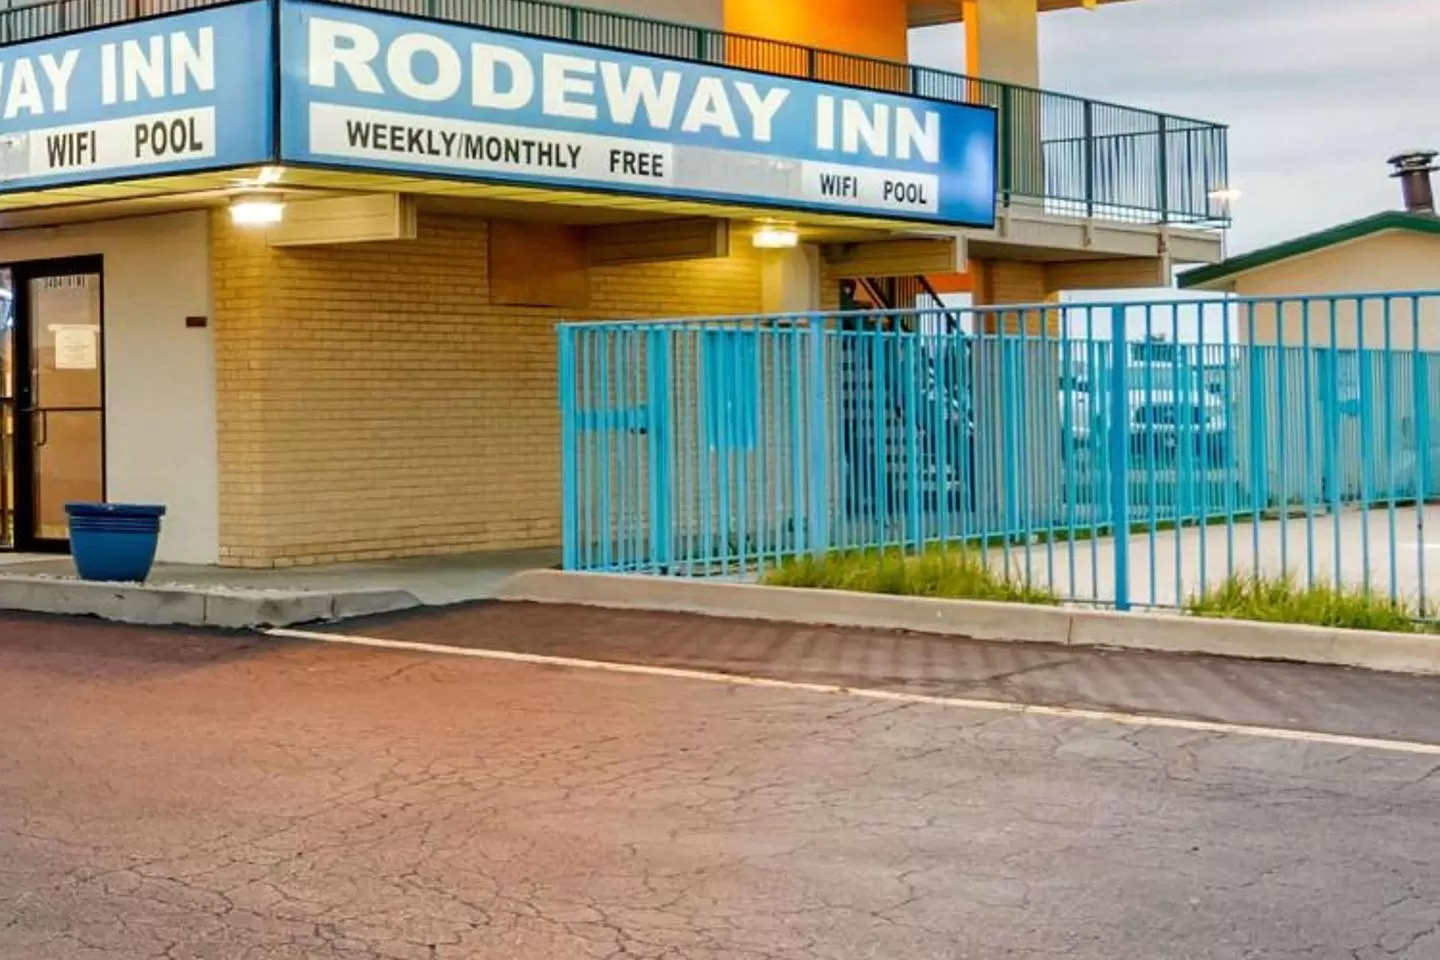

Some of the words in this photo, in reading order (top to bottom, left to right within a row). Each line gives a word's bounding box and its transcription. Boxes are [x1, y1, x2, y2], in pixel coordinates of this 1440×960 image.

[100, 25, 215, 105] INN
[308, 16, 791, 142] RODEWAY
[816, 92, 940, 164] INN
[46, 129, 97, 168] WIFI
[134, 116, 204, 158] POOL
[345, 120, 583, 169] WEEKLY/MONTHLY
[609, 148, 664, 178] FREE
[819, 173, 858, 199] WIFI
[882, 179, 928, 205] POOL
